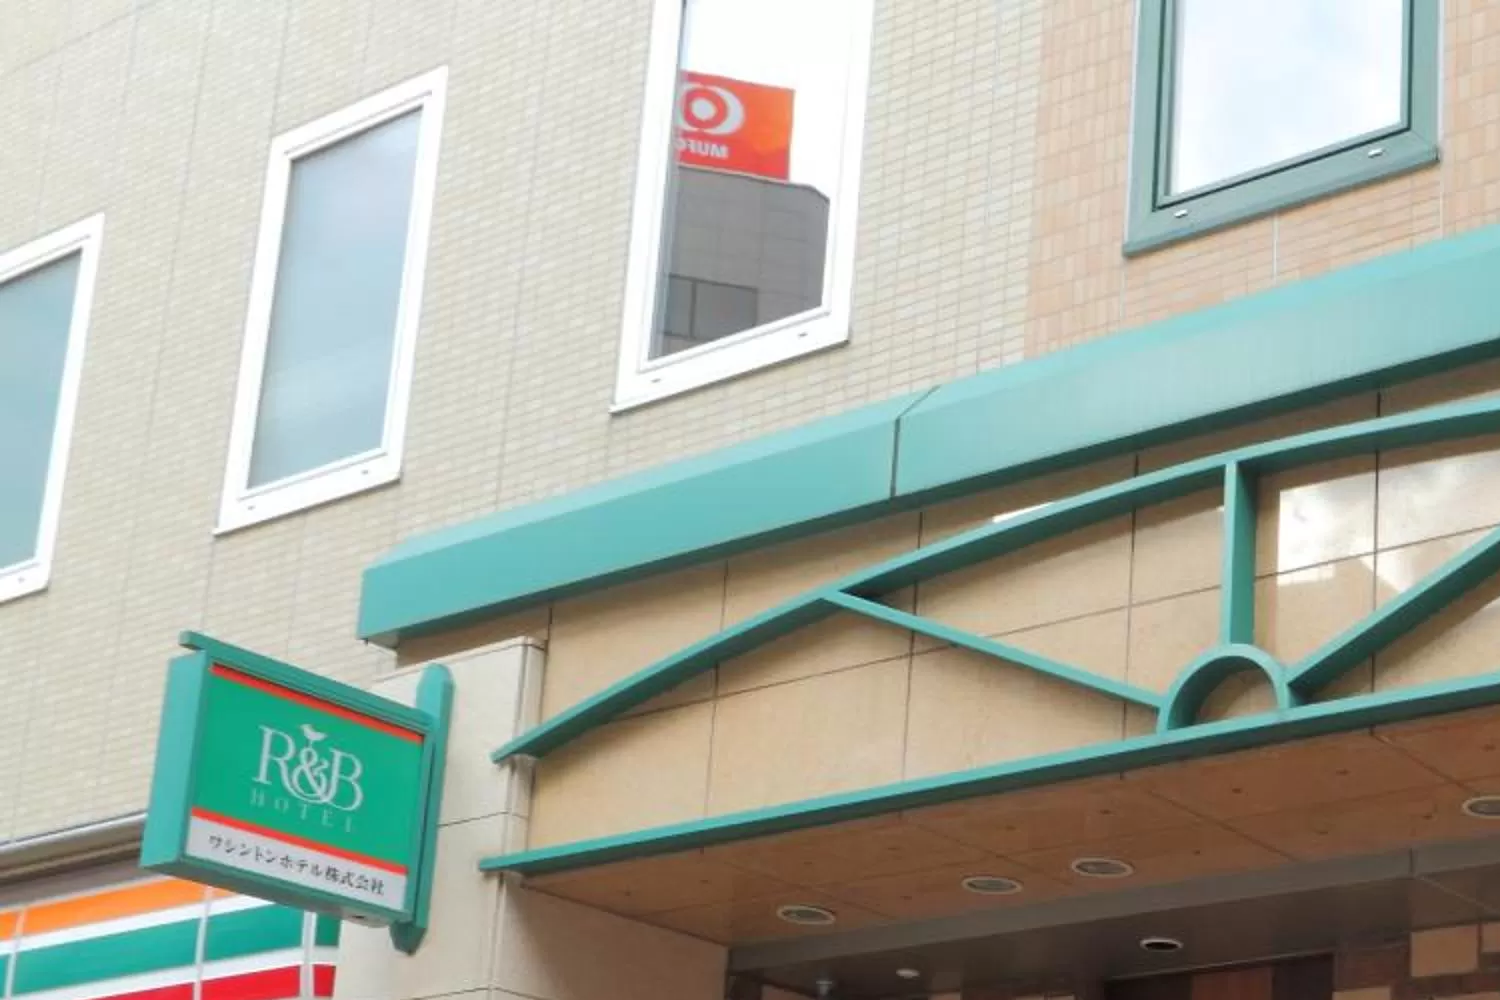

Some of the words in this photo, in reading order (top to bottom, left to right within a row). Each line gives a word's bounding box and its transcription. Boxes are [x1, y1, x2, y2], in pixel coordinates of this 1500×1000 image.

[252, 724, 364, 811] R&B
[250, 787, 356, 833] HOTEL
[208, 834, 386, 896] ワシントンホテル株式会社
